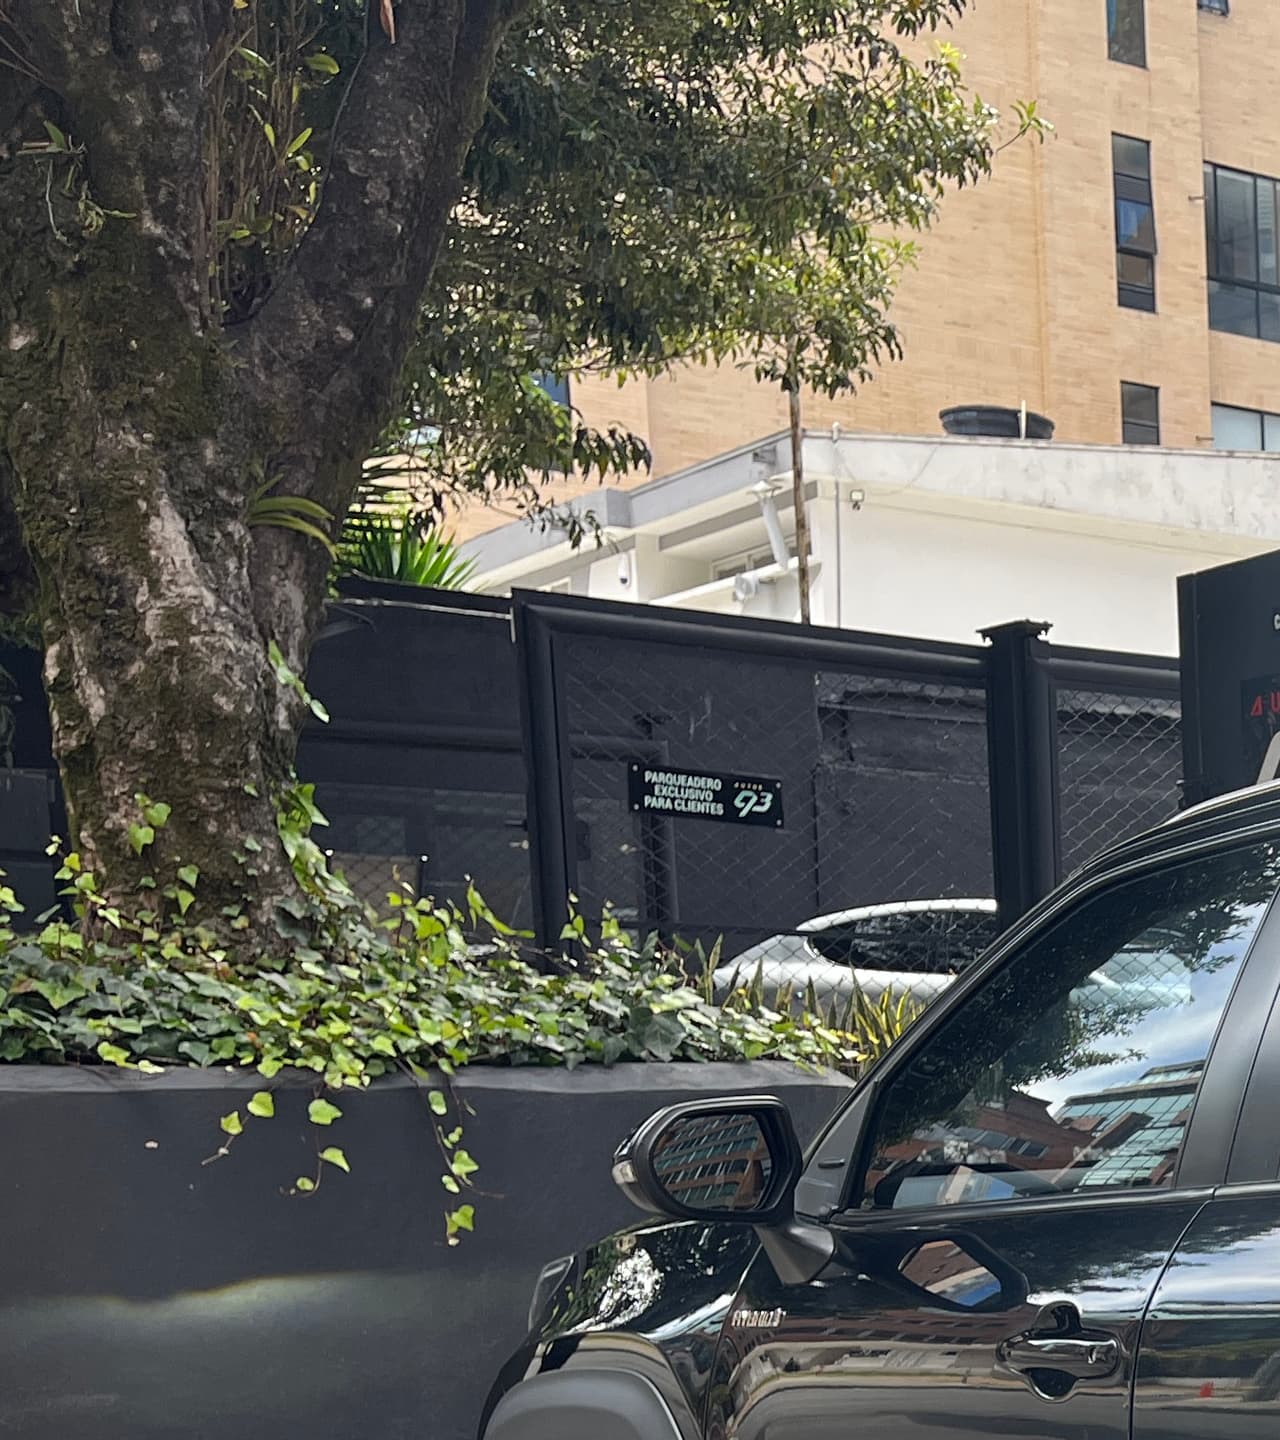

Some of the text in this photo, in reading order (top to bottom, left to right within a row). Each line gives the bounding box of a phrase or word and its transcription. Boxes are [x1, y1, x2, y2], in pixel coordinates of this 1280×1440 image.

[644, 770, 722, 791] PARQUEADERO
[654, 784, 714, 802] EXCLUSIVO
[733, 789, 773, 818] 93
[644, 794, 724, 816] PARA CLIENTES
